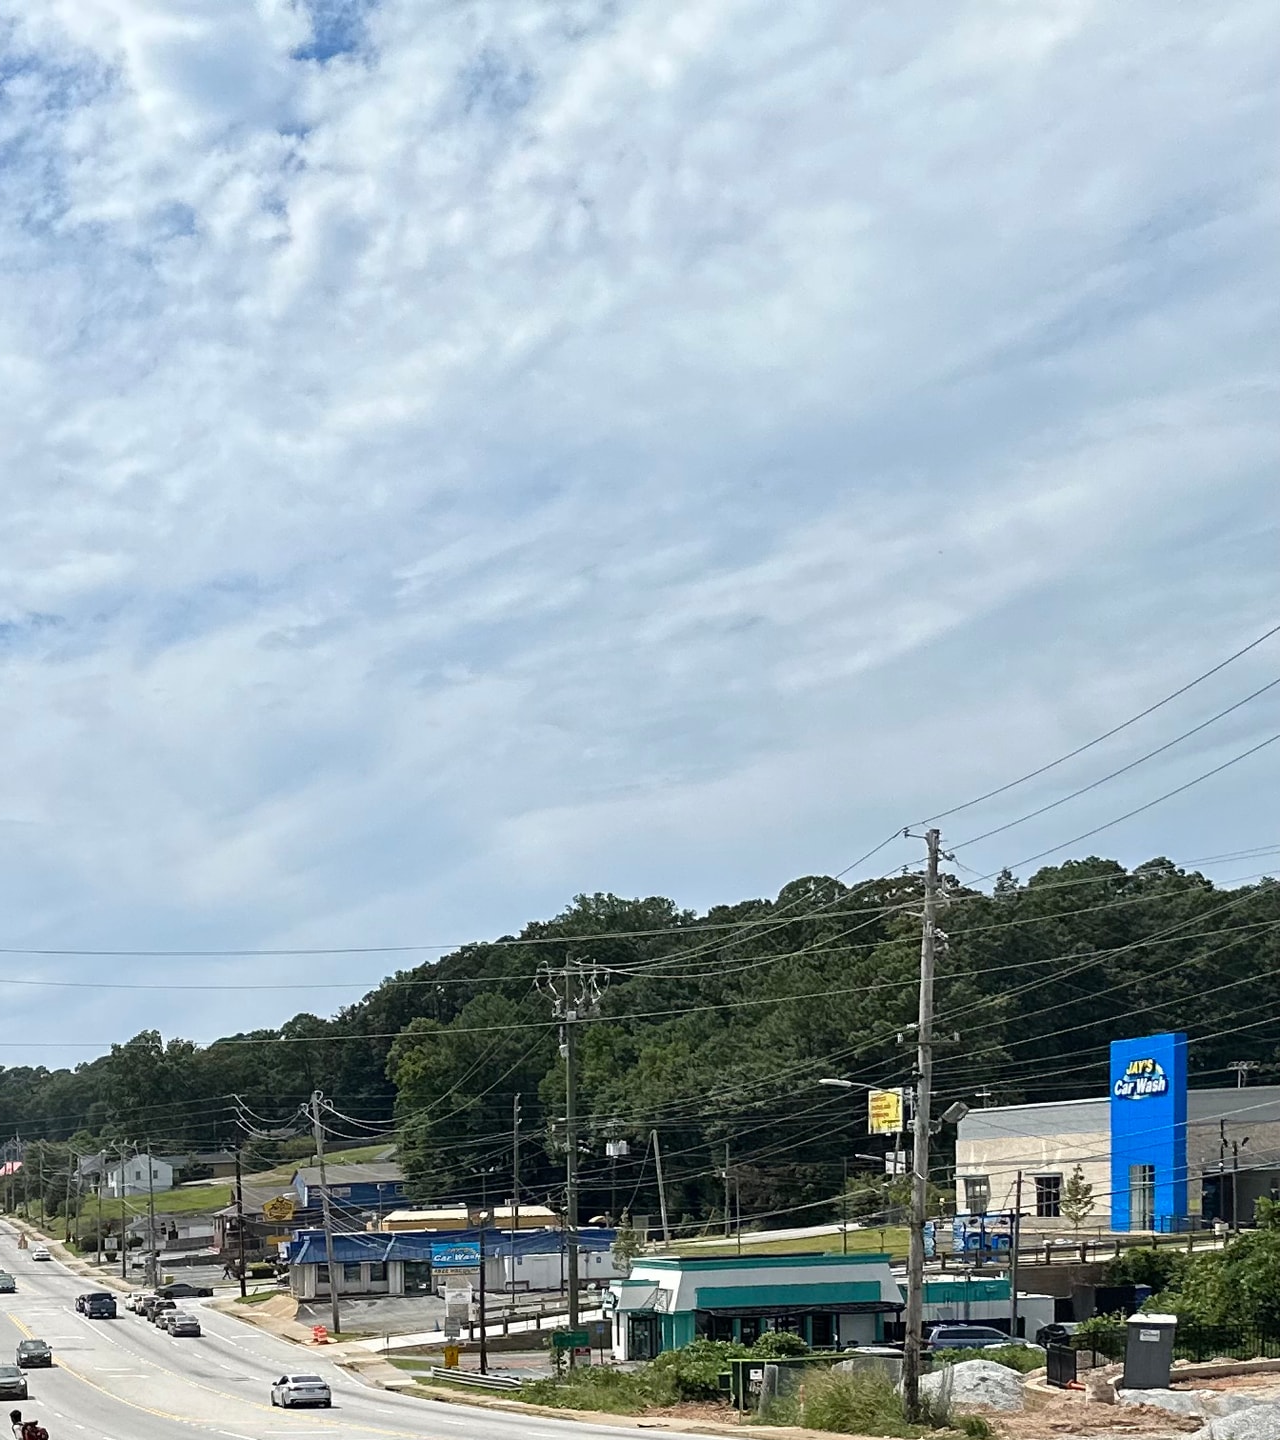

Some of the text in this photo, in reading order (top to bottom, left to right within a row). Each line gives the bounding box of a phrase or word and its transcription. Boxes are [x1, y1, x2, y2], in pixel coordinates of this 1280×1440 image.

[1126, 1059, 1153, 1074] JAY'S
[1114, 1076, 1166, 1095] Car Wash
